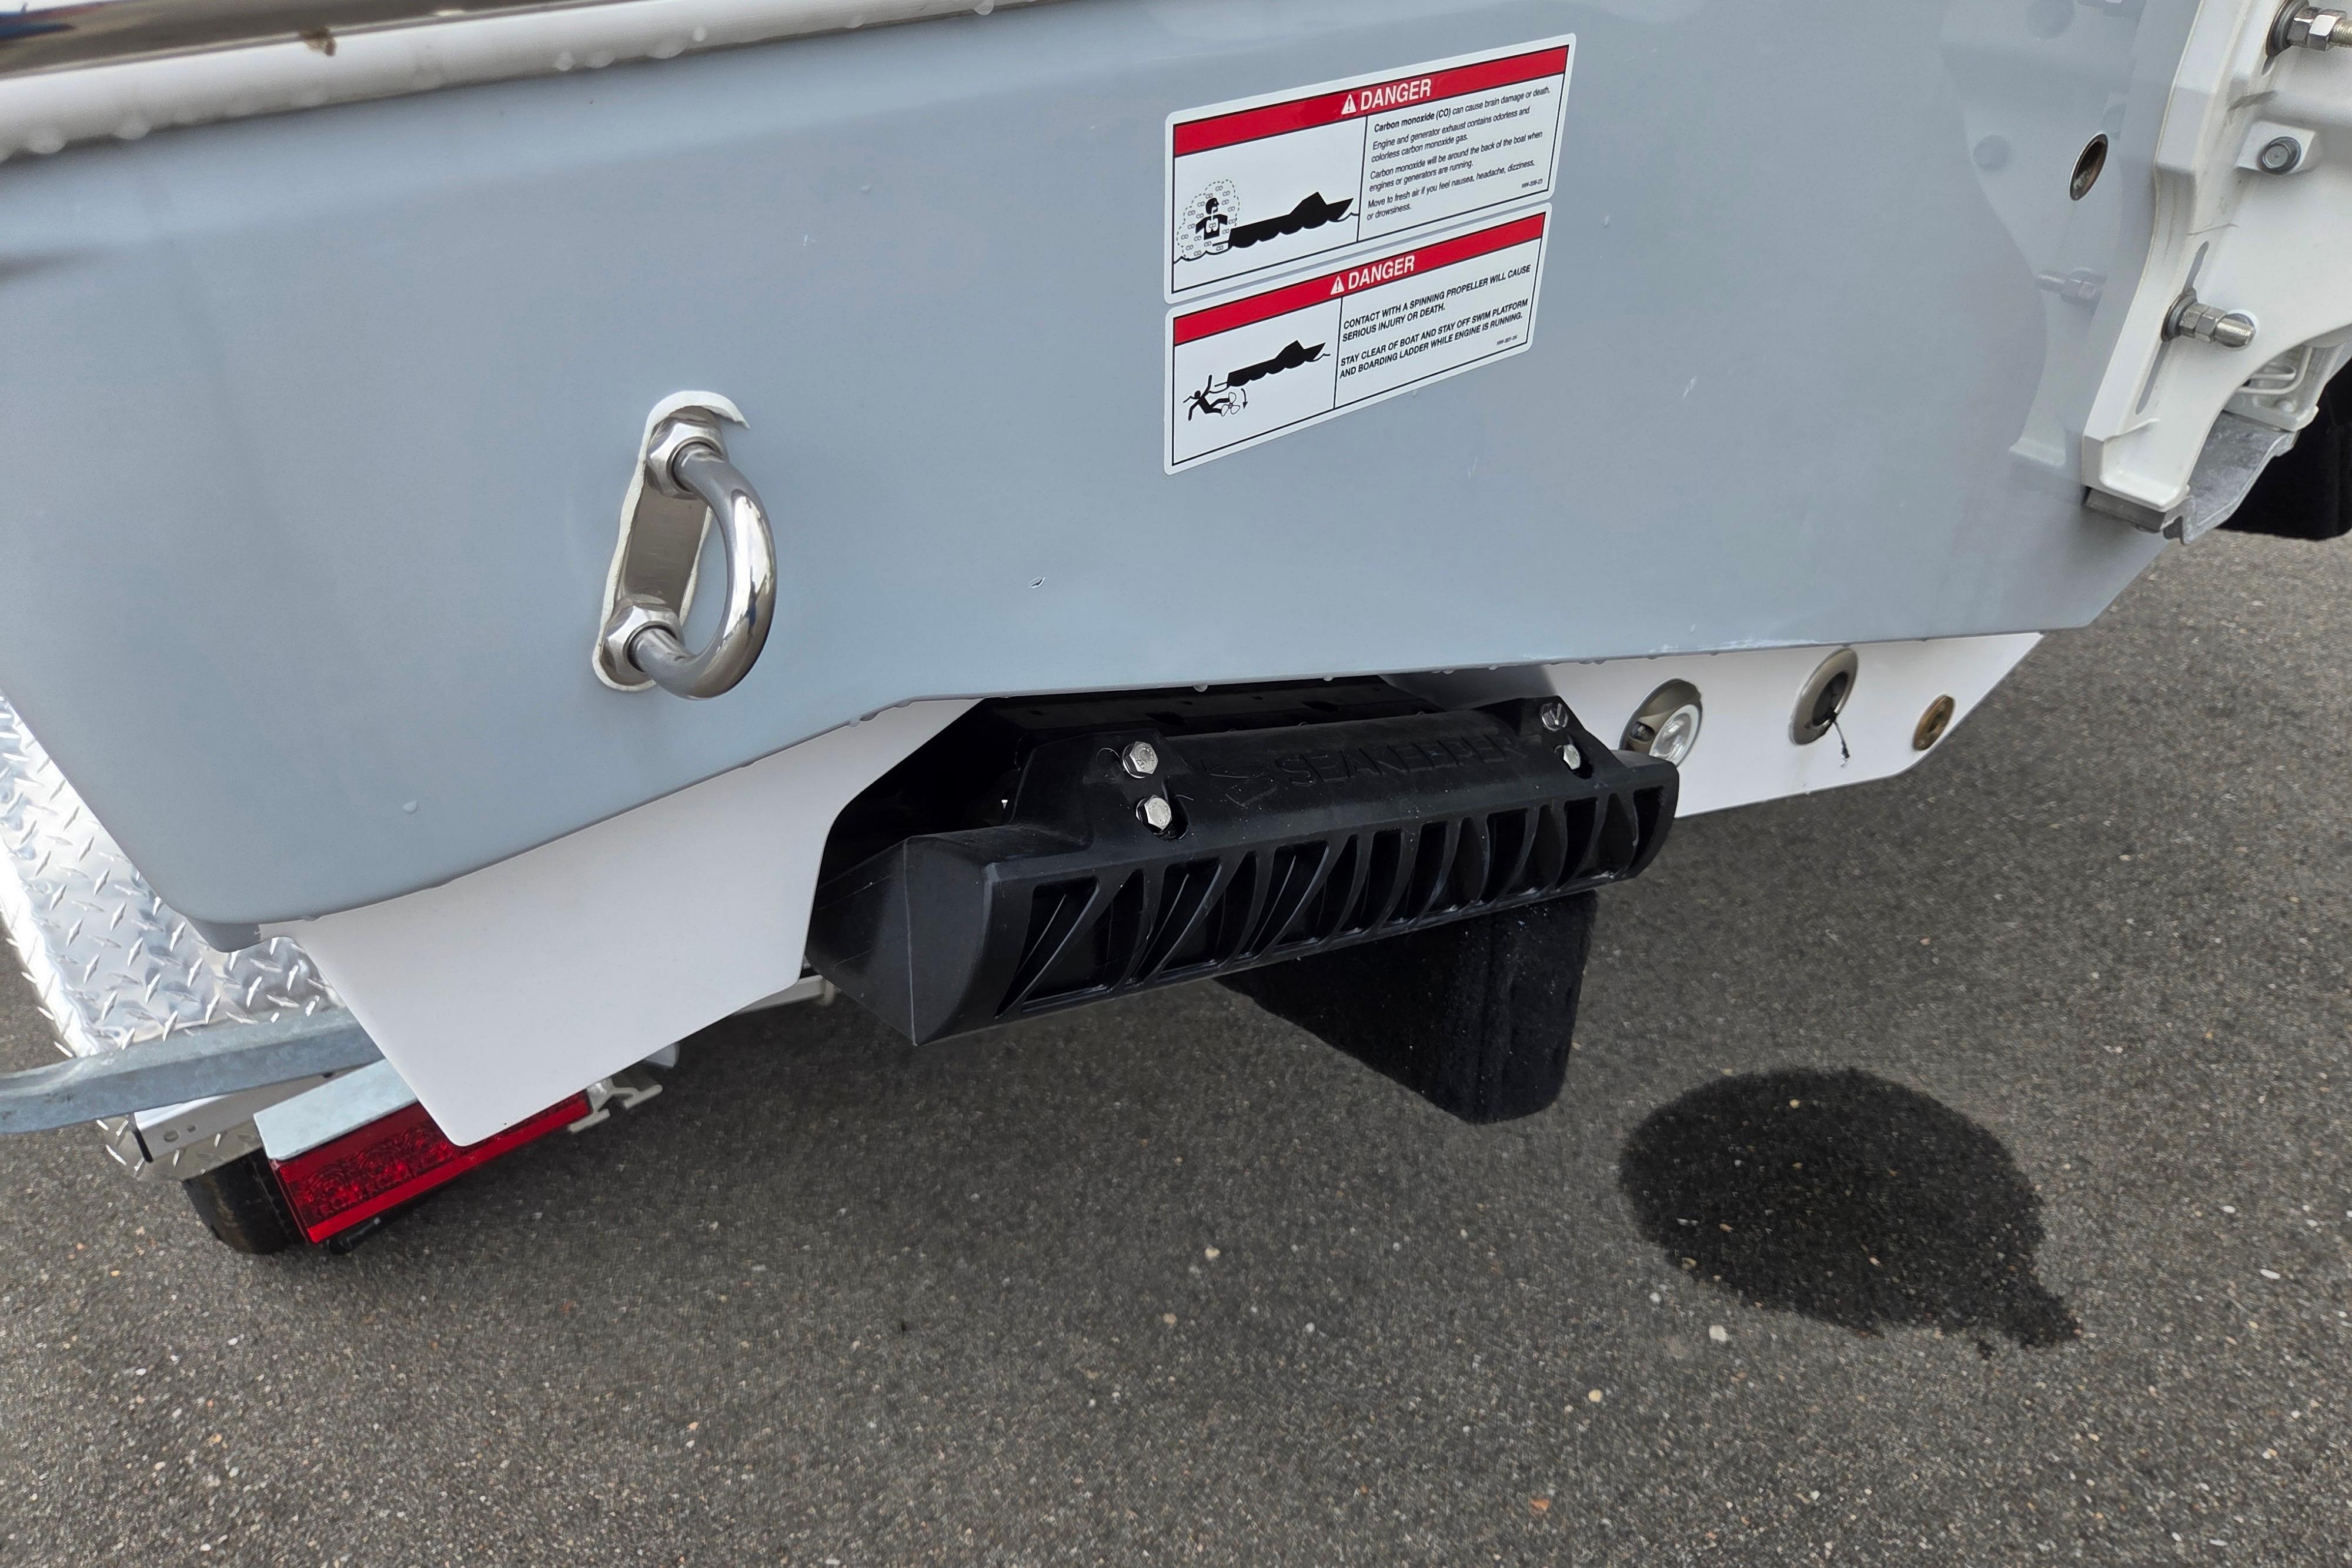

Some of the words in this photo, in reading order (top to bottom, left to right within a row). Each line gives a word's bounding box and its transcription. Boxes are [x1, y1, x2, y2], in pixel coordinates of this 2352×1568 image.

[1361, 79, 1431, 111] DANGER
[1374, 121, 1399, 132] Carbon
[1401, 112, 1435, 126] monoxide
[1436, 108, 1451, 121] (CO)
[1453, 106, 1463, 115] can
[1465, 102, 1483, 112] cause
[1485, 97, 1499, 108] brain
[1501, 92, 1524, 104] damage
[1371, 151, 1400, 163] colorless
[1401, 143, 1423, 155] carbon
[1424, 137, 1454, 150] monoxide
[1455, 134, 1468, 145] gas.
[1373, 138, 1395, 150] Engine
[1396, 134, 1409, 144] and
[1411, 128, 1441, 142] generator
[1442, 122, 1466, 134] exhaust
[1467, 115, 1492, 128] contains
[1493, 109, 1518, 122] odorless
[1519, 106, 1530, 115] and
[1370, 168, 1394, 179] Carbon
[1395, 159, 1425, 173] monoxide
[1427, 156, 1437, 165] will
[1438, 154, 1446, 163] be
[1447, 147, 1469, 161] around
[1470, 146, 1479, 155] the
[1481, 142, 1495, 152] back
[1496, 139, 1503, 148] of
[1503, 137, 1512, 146] the
[1514, 134, 1526, 145] boat
[1528, 131, 1542, 141] when
[1368, 198, 1385, 209] Move
[1387, 196, 1393, 204] to
[1395, 191, 1410, 202] fresh
[1411, 189, 1420, 198] air
[1421, 186, 1426, 195] if
[1426, 185, 1437, 196] you
[1439, 180, 1450, 190] feel
[1451, 176, 1474, 187] nausea,
[1476, 166, 1506, 180] headache,
[1507, 160, 1535, 172] dizziness,
[1369, 179, 1394, 192] engines
[1404, 168, 1436, 186] generators
[1438, 166, 1448, 175] are
[1449, 161, 1473, 172] running.
[1375, 203, 1411, 219] drowsiness.
[1348, 255, 1415, 290] DANGER
[1344, 311, 1380, 329] CONTACT
[1382, 304, 1401, 317] WITH
[1402, 303, 1408, 312] A
[1409, 291, 1445, 309] SPINNING
[1446, 278, 1488, 298] PROPELLER
[1489, 272, 1506, 284] WILL
[1508, 265, 1531, 278] CAUSE
[1341, 353, 1360, 366] STAY
[1361, 345, 1386, 359] CLEAR
[1388, 340, 1399, 351] OF
[1400, 334, 1420, 347] BOAT
[1420, 329, 1436, 340] AND
[1438, 320, 1456, 335] STAY
[1456, 317, 1471, 328] OFF
[1471, 310, 1491, 323] SWIM
[1492, 298, 1528, 317] PLATFORM
[1342, 325, 1377, 342] SERIOUS
[1378, 314, 1406, 331] INJURY
[1407, 312, 1418, 322] OR
[1419, 303, 1445, 317] DEATH.
[1339, 366, 1357, 379] AND
[1358, 353, 1398, 373] BOARDING
[1399, 342, 1429, 359] LADDER
[1431, 334, 1453, 348] WHILE
[1455, 325, 1481, 340] ENGINE
[1482, 322, 1489, 331] IS
[1490, 312, 1522, 328] RUNNING.
[1275, 734, 1528, 787] SEAKEEPER
